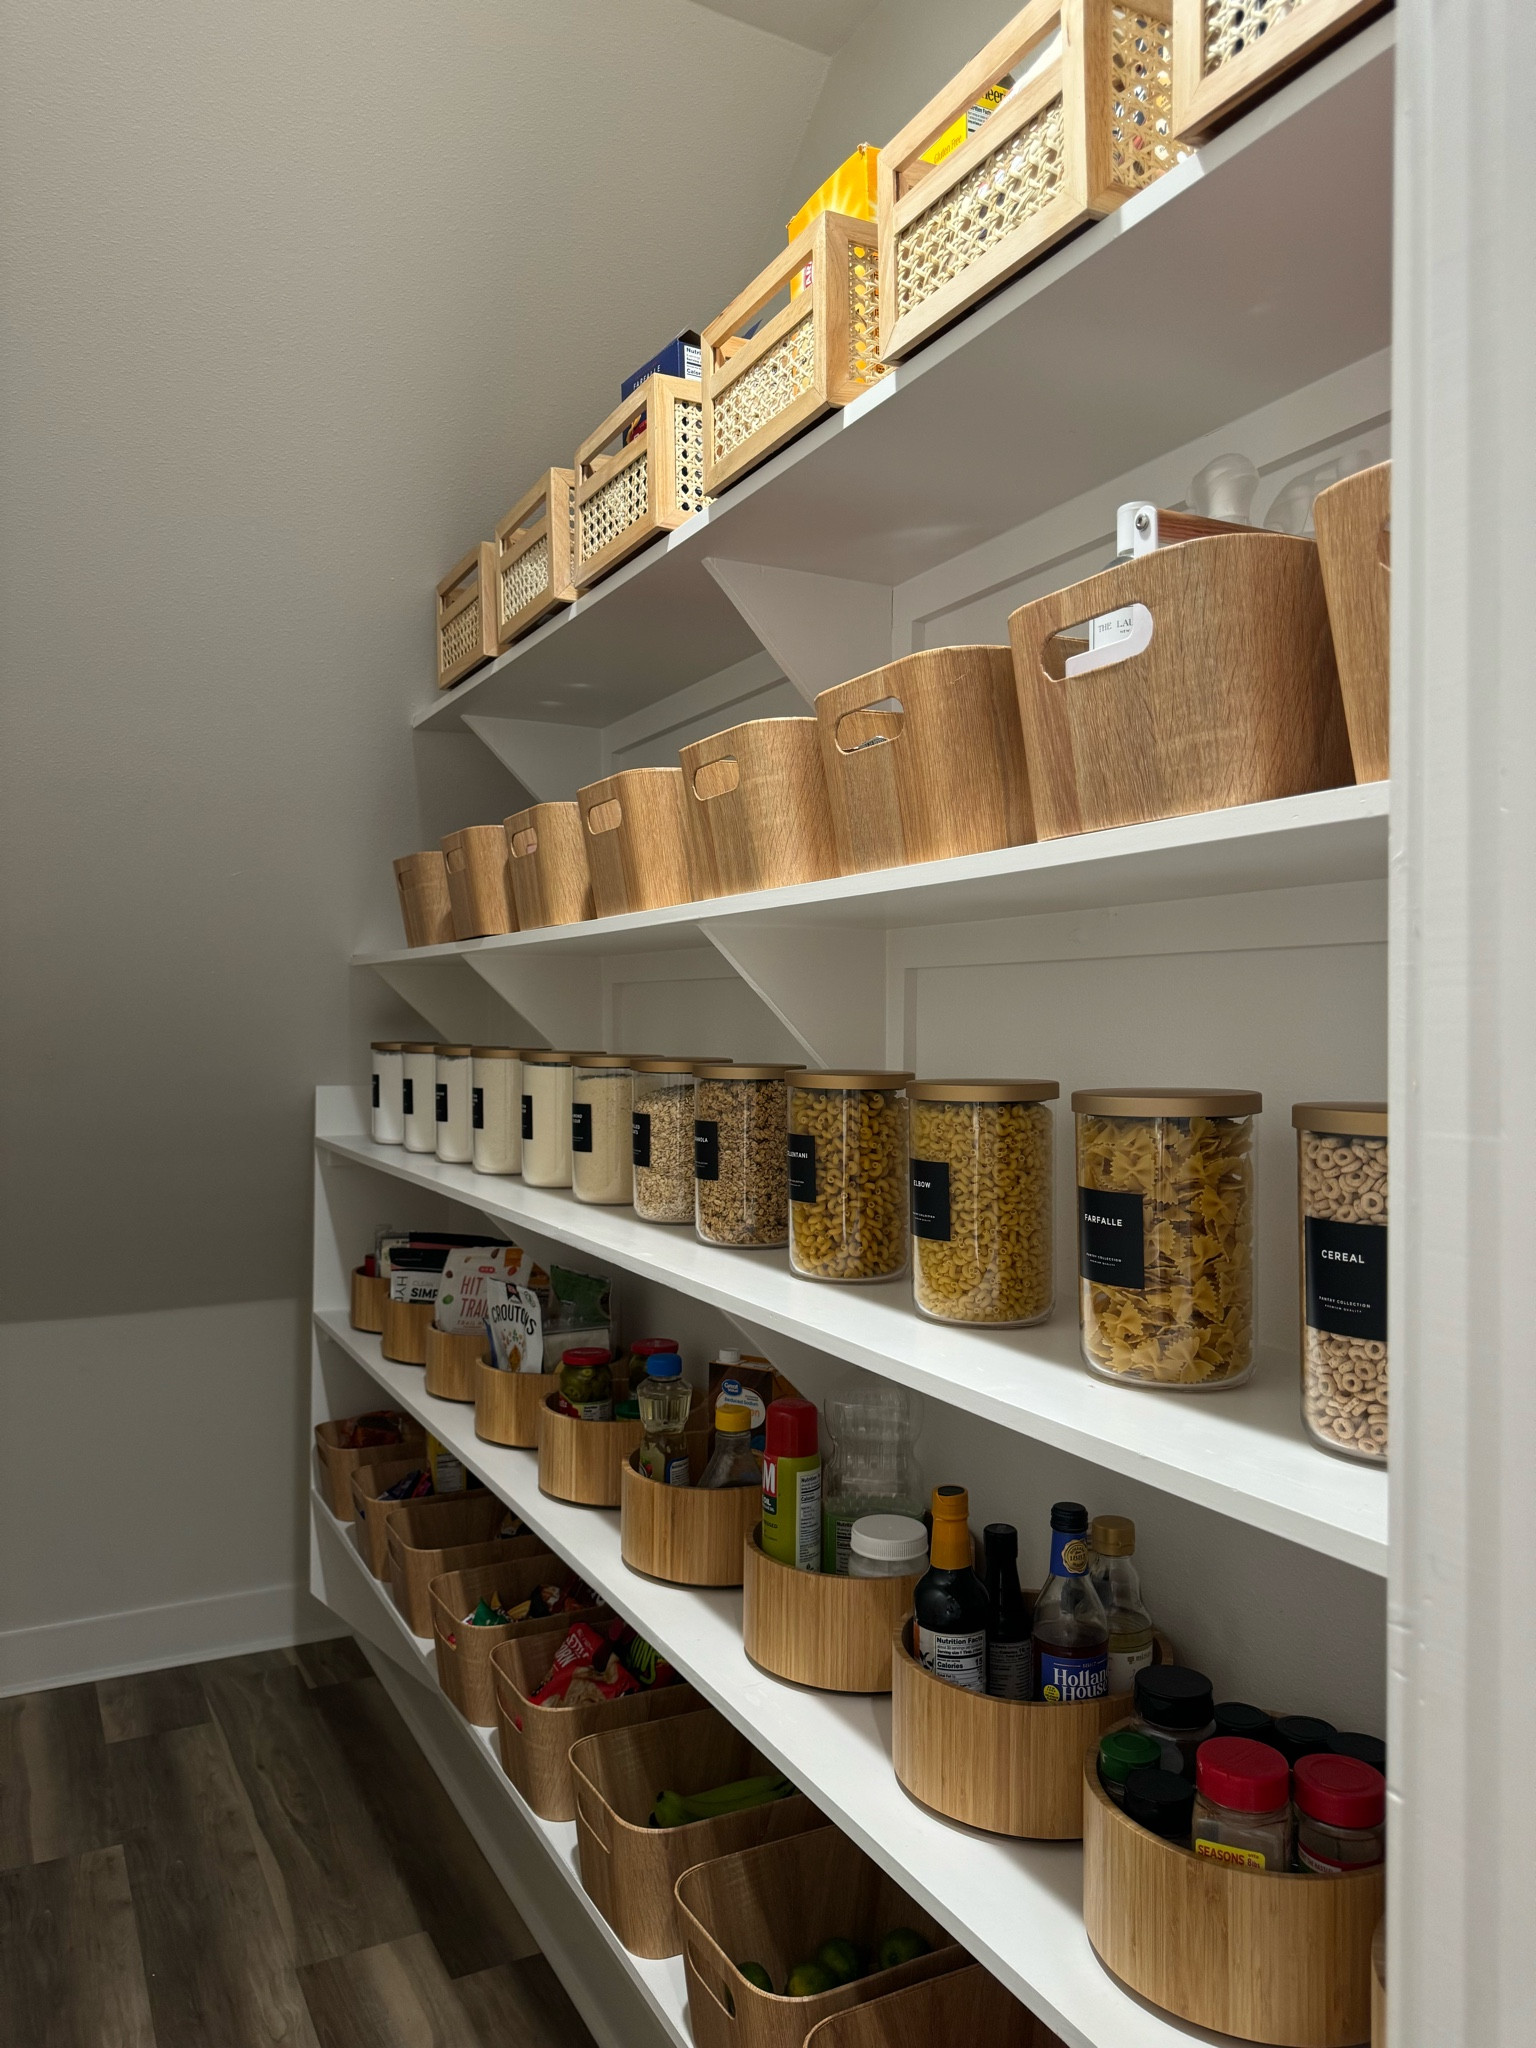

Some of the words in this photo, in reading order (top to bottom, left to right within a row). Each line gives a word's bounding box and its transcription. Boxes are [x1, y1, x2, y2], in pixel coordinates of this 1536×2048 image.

[1098, 621, 1112, 632] THE
[914, 1180, 931, 1188] ELBOW
[1085, 1214, 1122, 1226] FARFALLE
[1321, 1249, 1365, 1264] CEREAL
[461, 1276, 484, 1295] HIT
[1337, 1300, 1370, 1308] COLLECTION
[1053, 1667, 1108, 1686] Hollan
[1198, 1844, 1244, 1865] SEASONS
